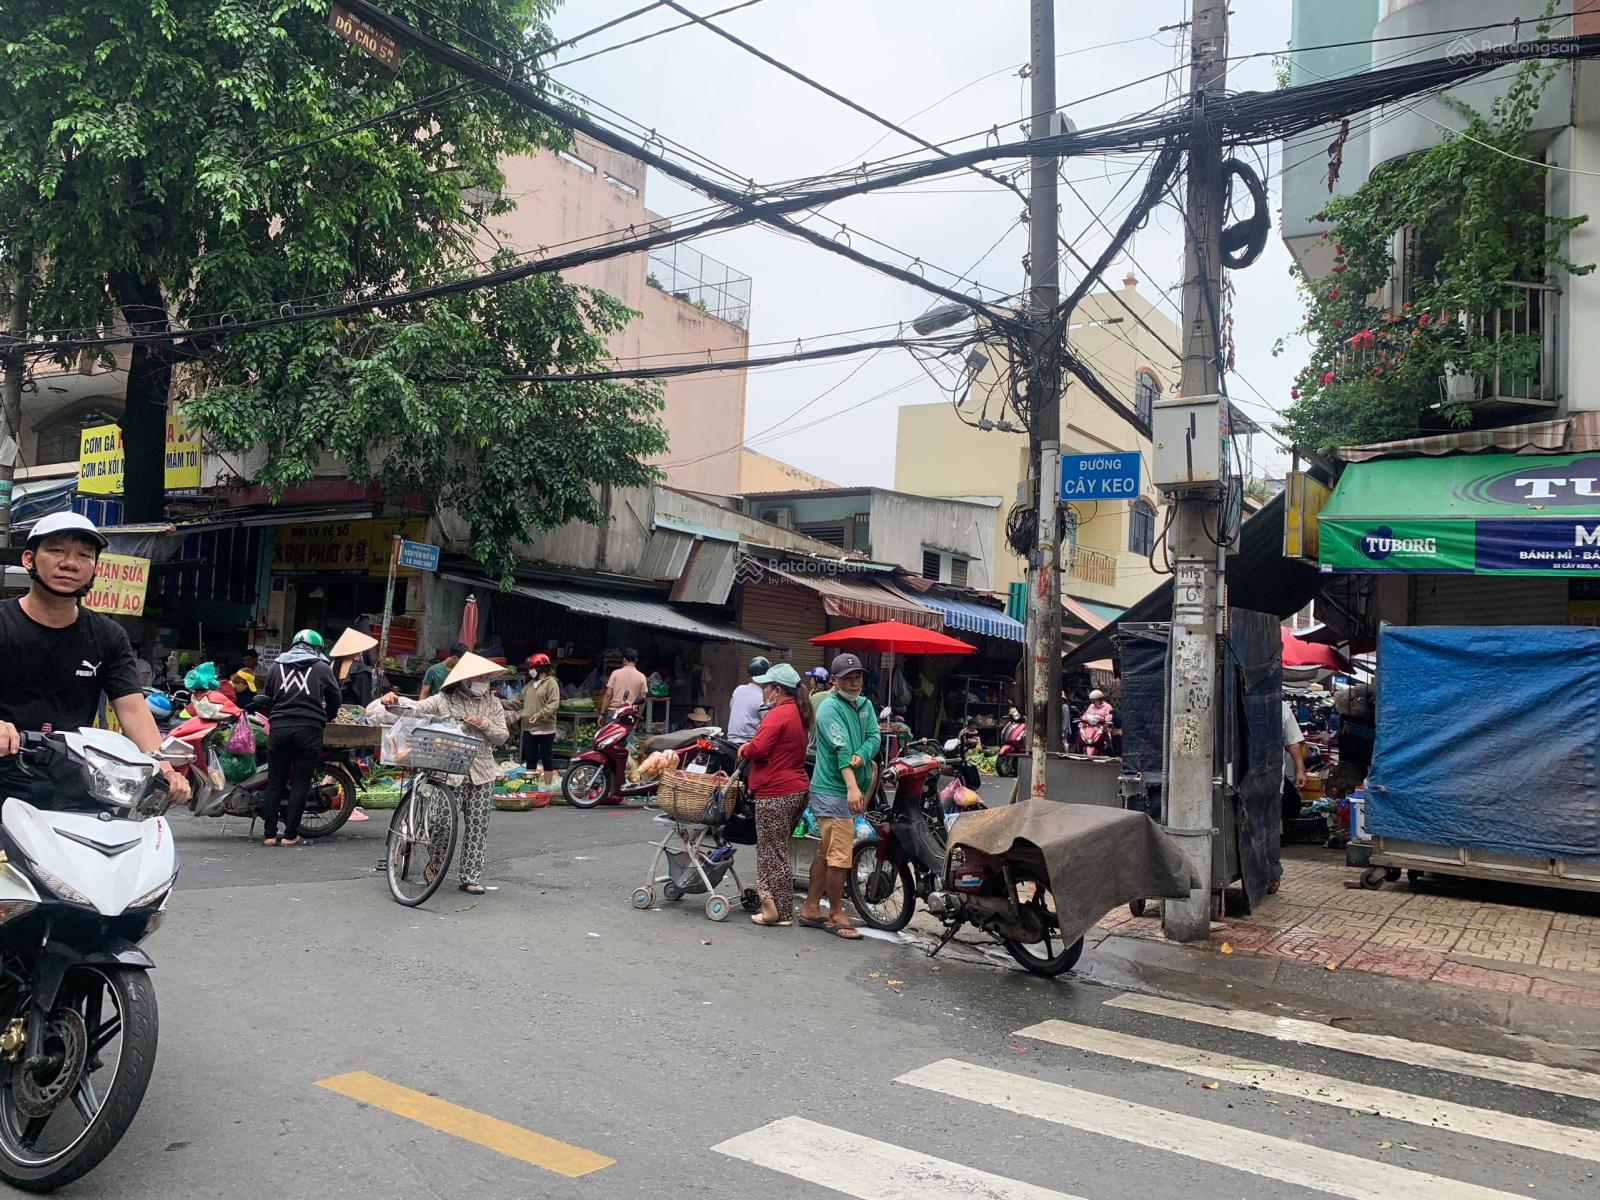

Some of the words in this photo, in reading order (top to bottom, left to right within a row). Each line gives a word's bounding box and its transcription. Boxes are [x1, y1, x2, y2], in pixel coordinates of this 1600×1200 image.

[355, 29, 377, 52] CAO
[84, 435, 102, 455] CƠM
[1079, 457, 1122, 471] ĐƯỜNG
[1065, 474, 1097, 494] CÂY
[1101, 477, 1135, 493] KEO
[1366, 537, 1437, 553] TUBORG
[1519, 549, 1554, 559] BÁNH
[1557, 549, 1572, 559] MÌ
[95, 559, 120, 582] HẬN
